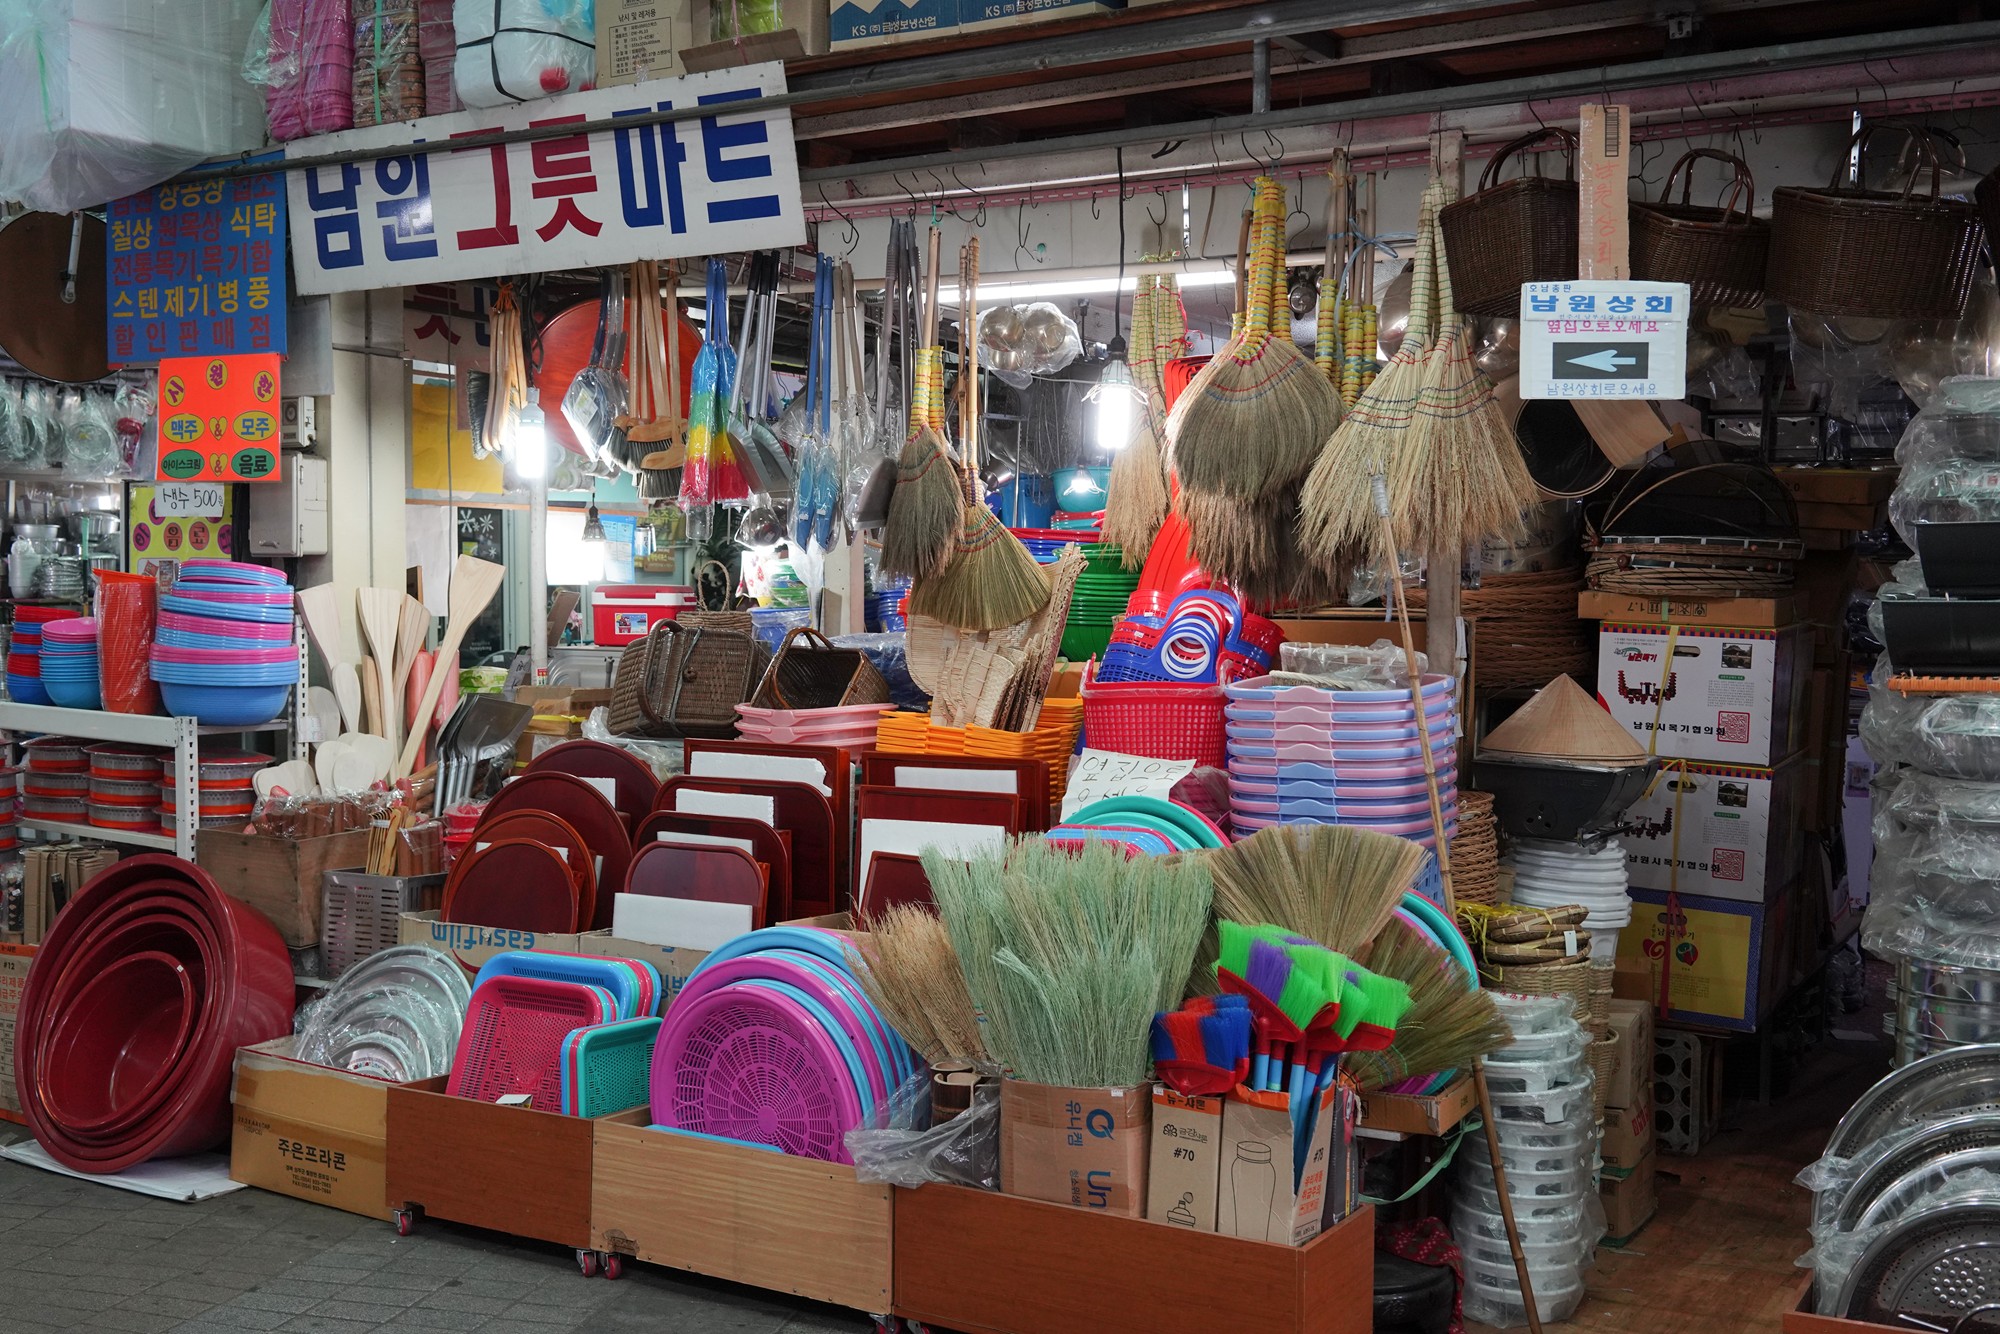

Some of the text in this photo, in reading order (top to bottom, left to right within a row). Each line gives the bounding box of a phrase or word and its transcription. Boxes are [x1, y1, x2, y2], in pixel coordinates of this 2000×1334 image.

[985, 6, 1001, 17] KS
[851, 26, 867, 37] KS
[869, 24, 881, 34] (주)
[112, 203, 277, 252] 칠상 원목상 식탁
[1530, 295, 1673, 314] 남원상회
[1547, 320, 1660, 334] 옆집으로오세요
[1547, 383, 1658, 396] 남원상회로오세요
[171, 418, 270, 440] 맥주 & 모주
[163, 455, 268, 475] 아이스크림 & 음료
[163, 488, 189, 510] 생수
[1627, 602, 1645, 612] 1.7
[1082, 756, 1187, 782] 옆집으로
[4, 962, 15, 970] #12
[1065, 1100, 1084, 1147] 유니켐
[278, 1138, 346, 1172] 주은프라콘
[1173, 1147, 1195, 1162] #70
